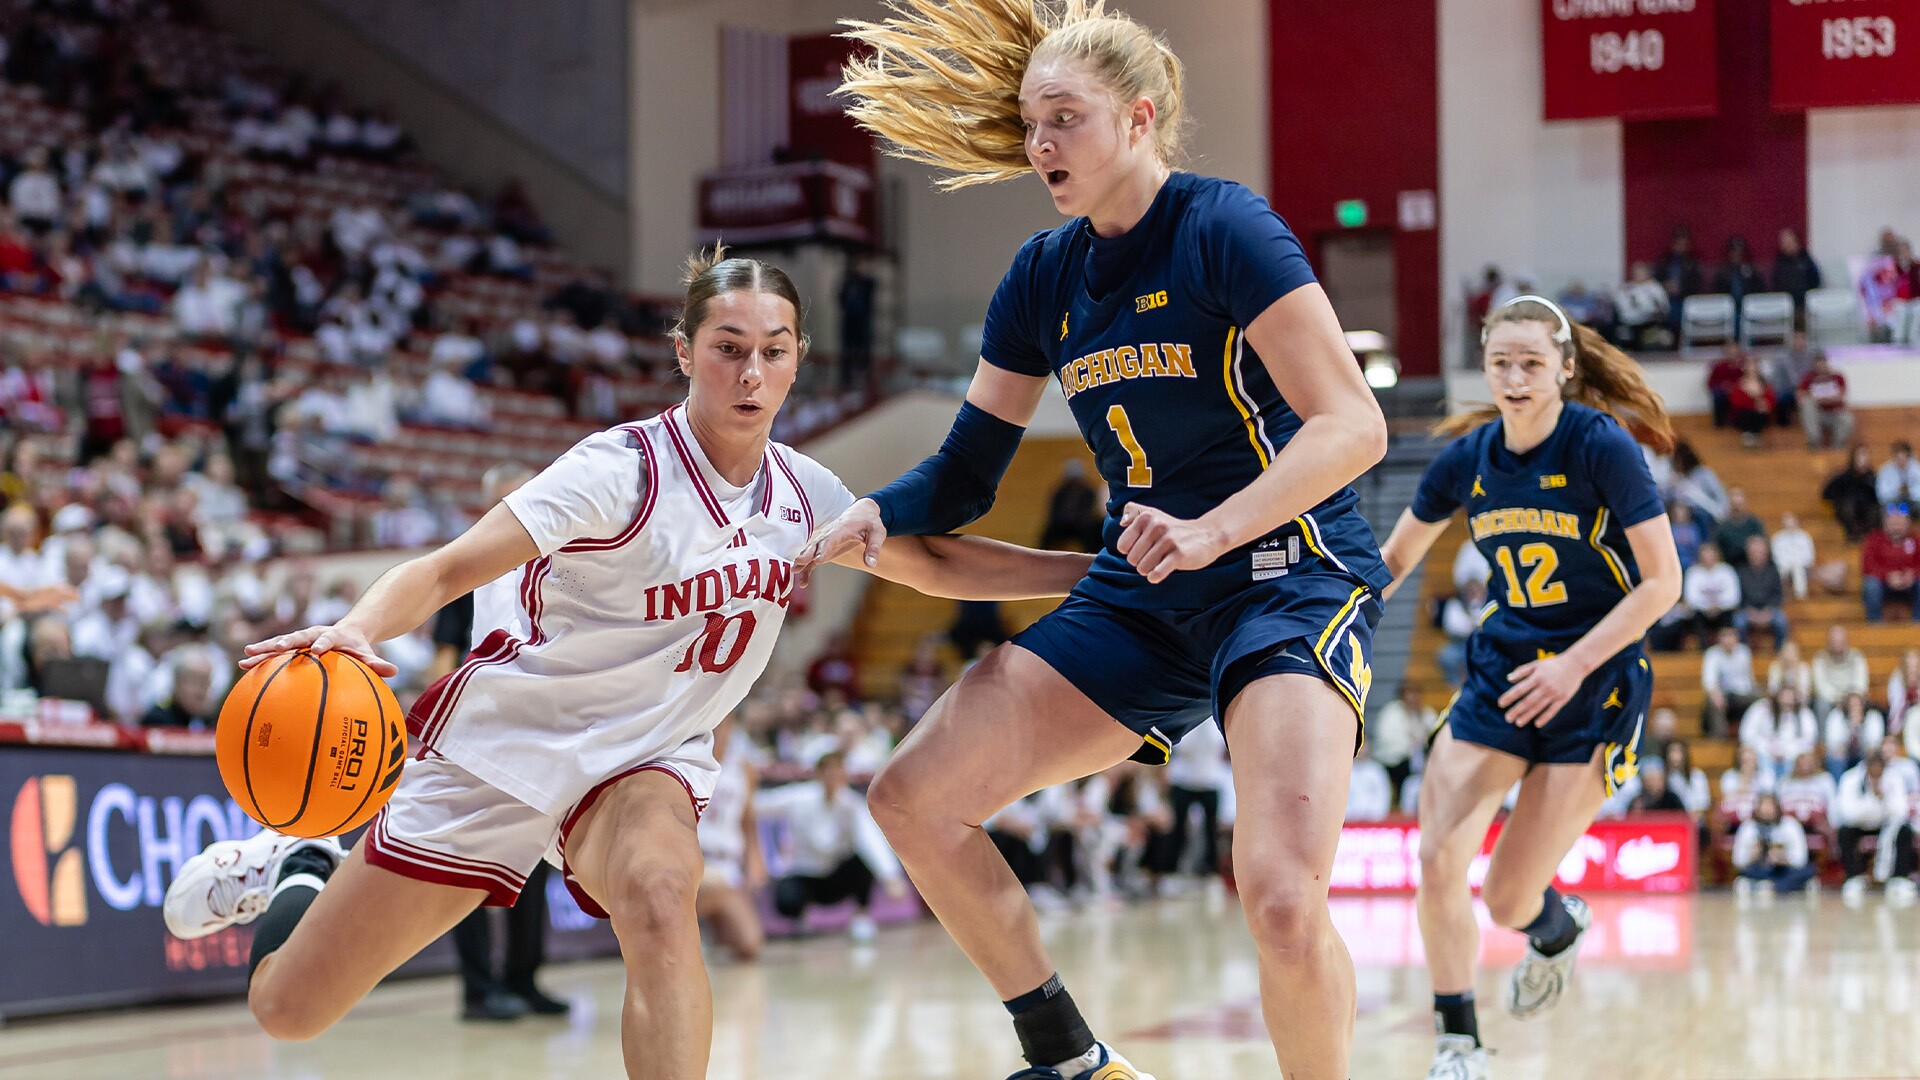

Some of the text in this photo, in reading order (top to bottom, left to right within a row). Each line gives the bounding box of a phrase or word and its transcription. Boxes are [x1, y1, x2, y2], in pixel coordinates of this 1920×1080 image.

[1590, 29, 1664, 74] 1940
[1822, 16, 1896, 59] 1953
[1060, 343, 1198, 400] MICHIGAN
[1106, 404, 1152, 488] 1
[1470, 507, 1581, 541] MICHIGAN
[644, 558, 792, 621] INDIAN
[1495, 542, 1568, 608] 12
[674, 611, 757, 673] 10
[329, 716, 349, 788] OFFICIAL GAME BALL
[340, 719, 367, 791] PRO 1
